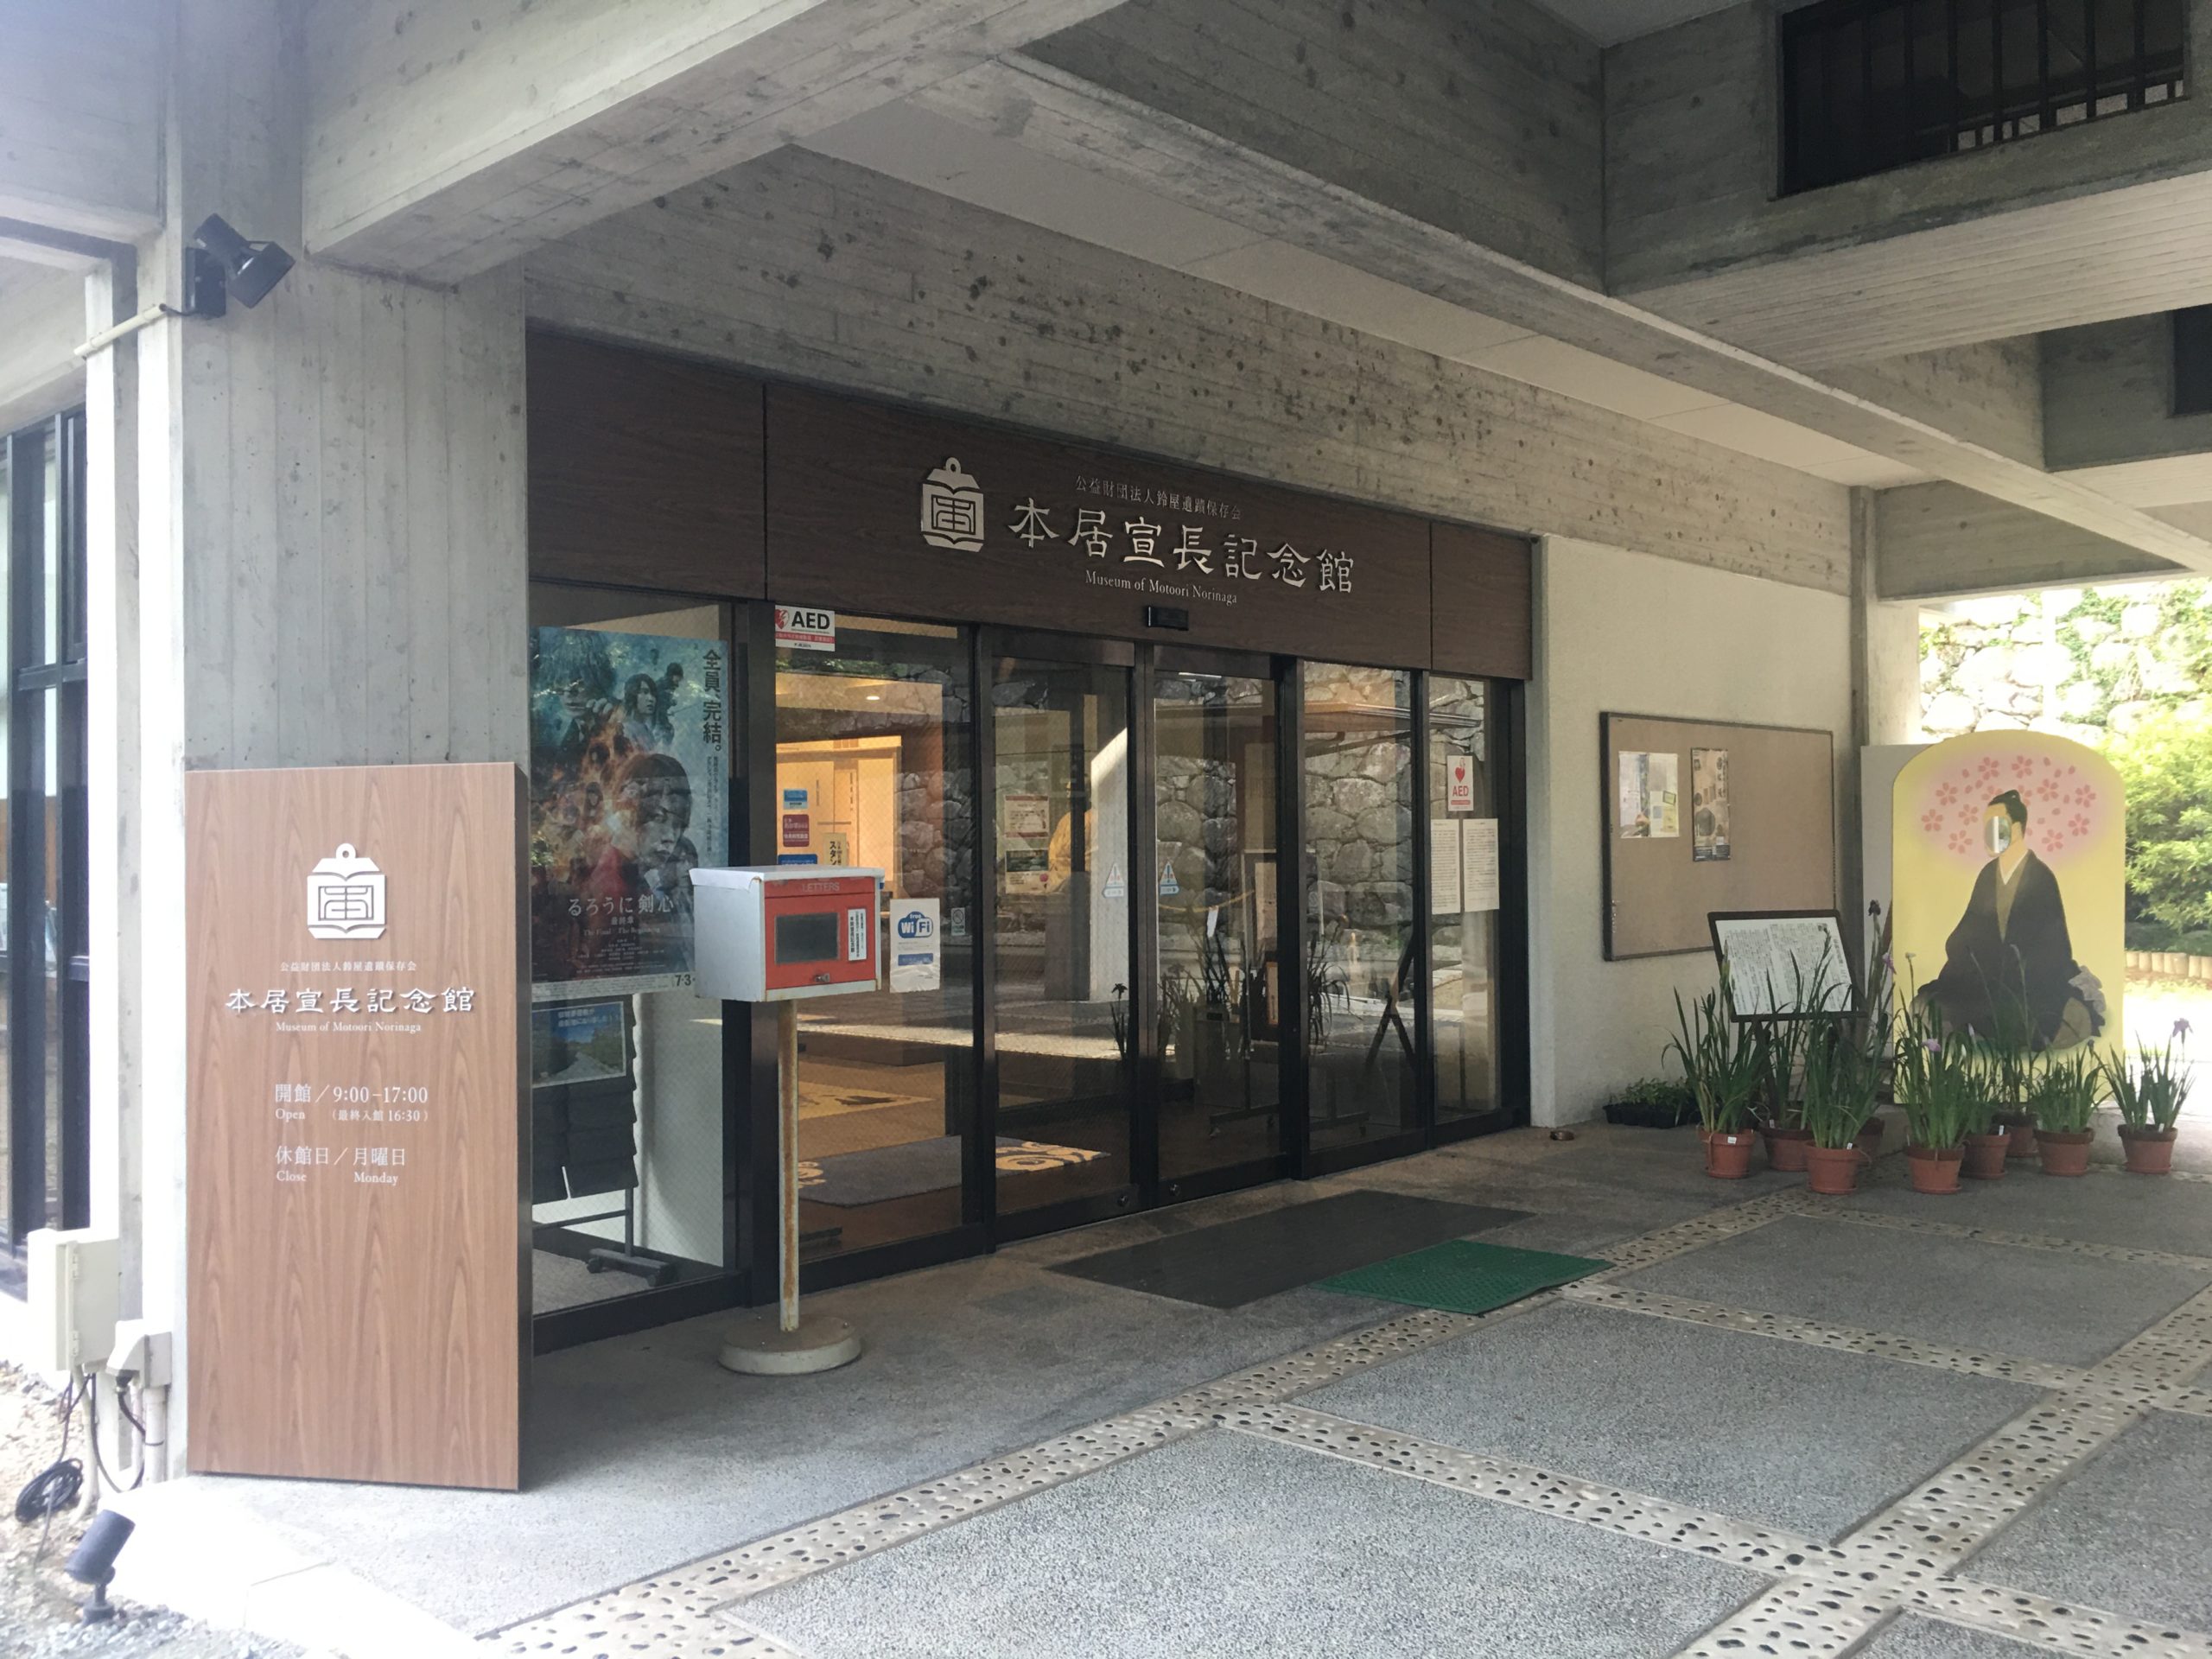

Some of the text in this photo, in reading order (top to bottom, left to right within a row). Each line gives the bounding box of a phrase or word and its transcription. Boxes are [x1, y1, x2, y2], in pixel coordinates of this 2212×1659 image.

[1076, 475, 1241, 520] 公益財団法人鈴屋遺蹟保存会
[1007, 497, 1354, 594] 本居宣長記念館
[1085, 569, 1237, 606] Museum of Motoori Norinaga
[791, 610, 830, 630] AED
[702, 650, 722, 752] 全員、完結。
[1452, 785, 1469, 797] AED
[802, 882, 840, 893] LETTERS
[568, 893, 674, 917] るろうに剣心
[611, 916, 634, 925] 最終章
[225, 987, 475, 1014] 本居宣長記念館
[276, 1021, 422, 1034] Museum of Motoori Norinaga
[275, 1109, 306, 1122] Open
[276, 1171, 308, 1182] Close
[353, 1171, 399, 1186] Monday
